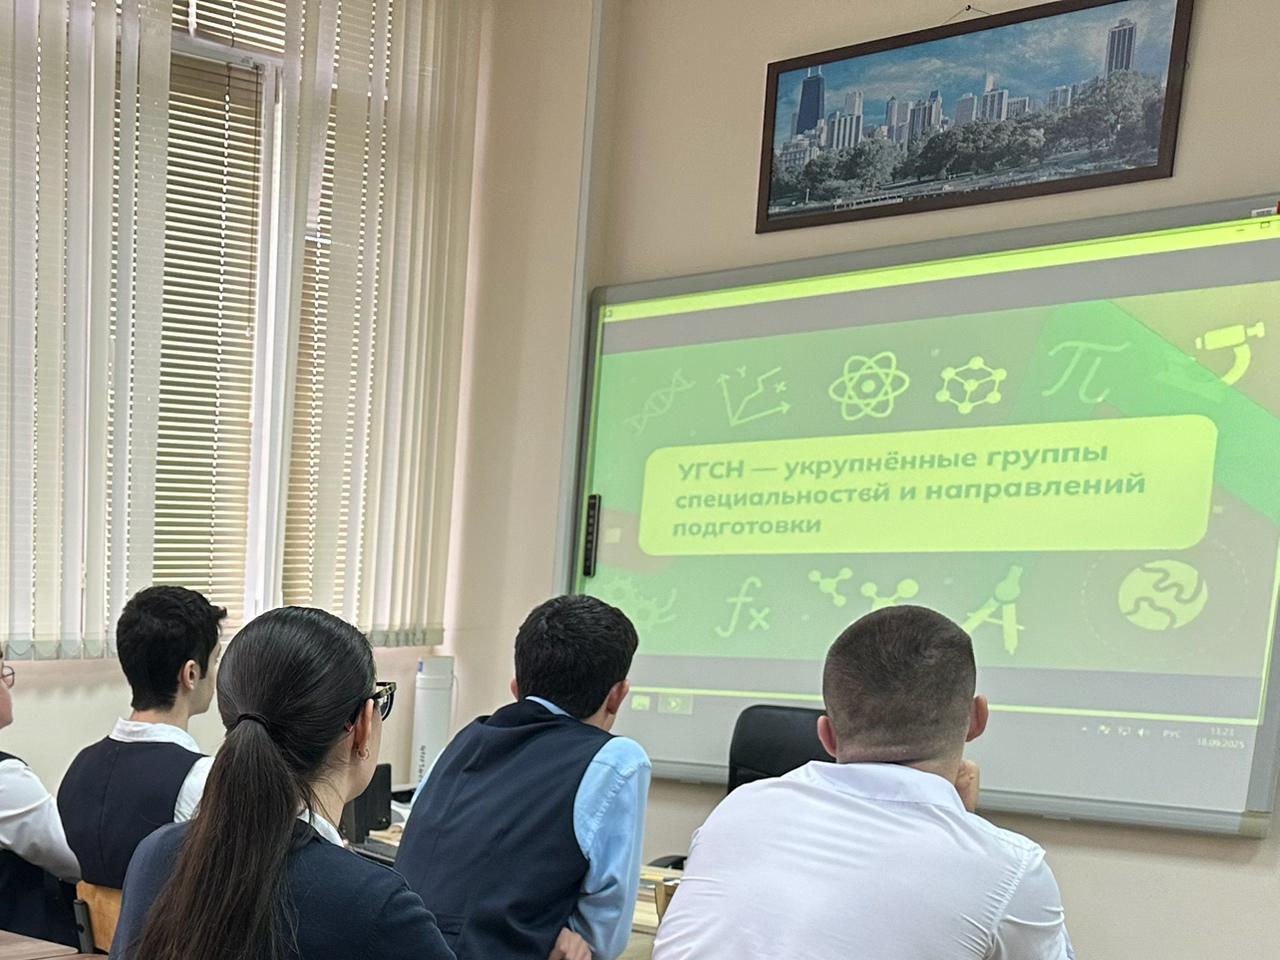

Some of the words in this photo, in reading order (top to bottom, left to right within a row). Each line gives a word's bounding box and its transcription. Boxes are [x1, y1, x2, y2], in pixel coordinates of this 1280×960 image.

[678, 460, 745, 481] УГСН
[784, 451, 977, 482] укрупнённые
[986, 445, 1108, 471] группы
[675, 482, 890, 510] специальностей
[900, 485, 916, 500] и
[925, 472, 1146, 503] направлений
[672, 518, 822, 538] подготовки
